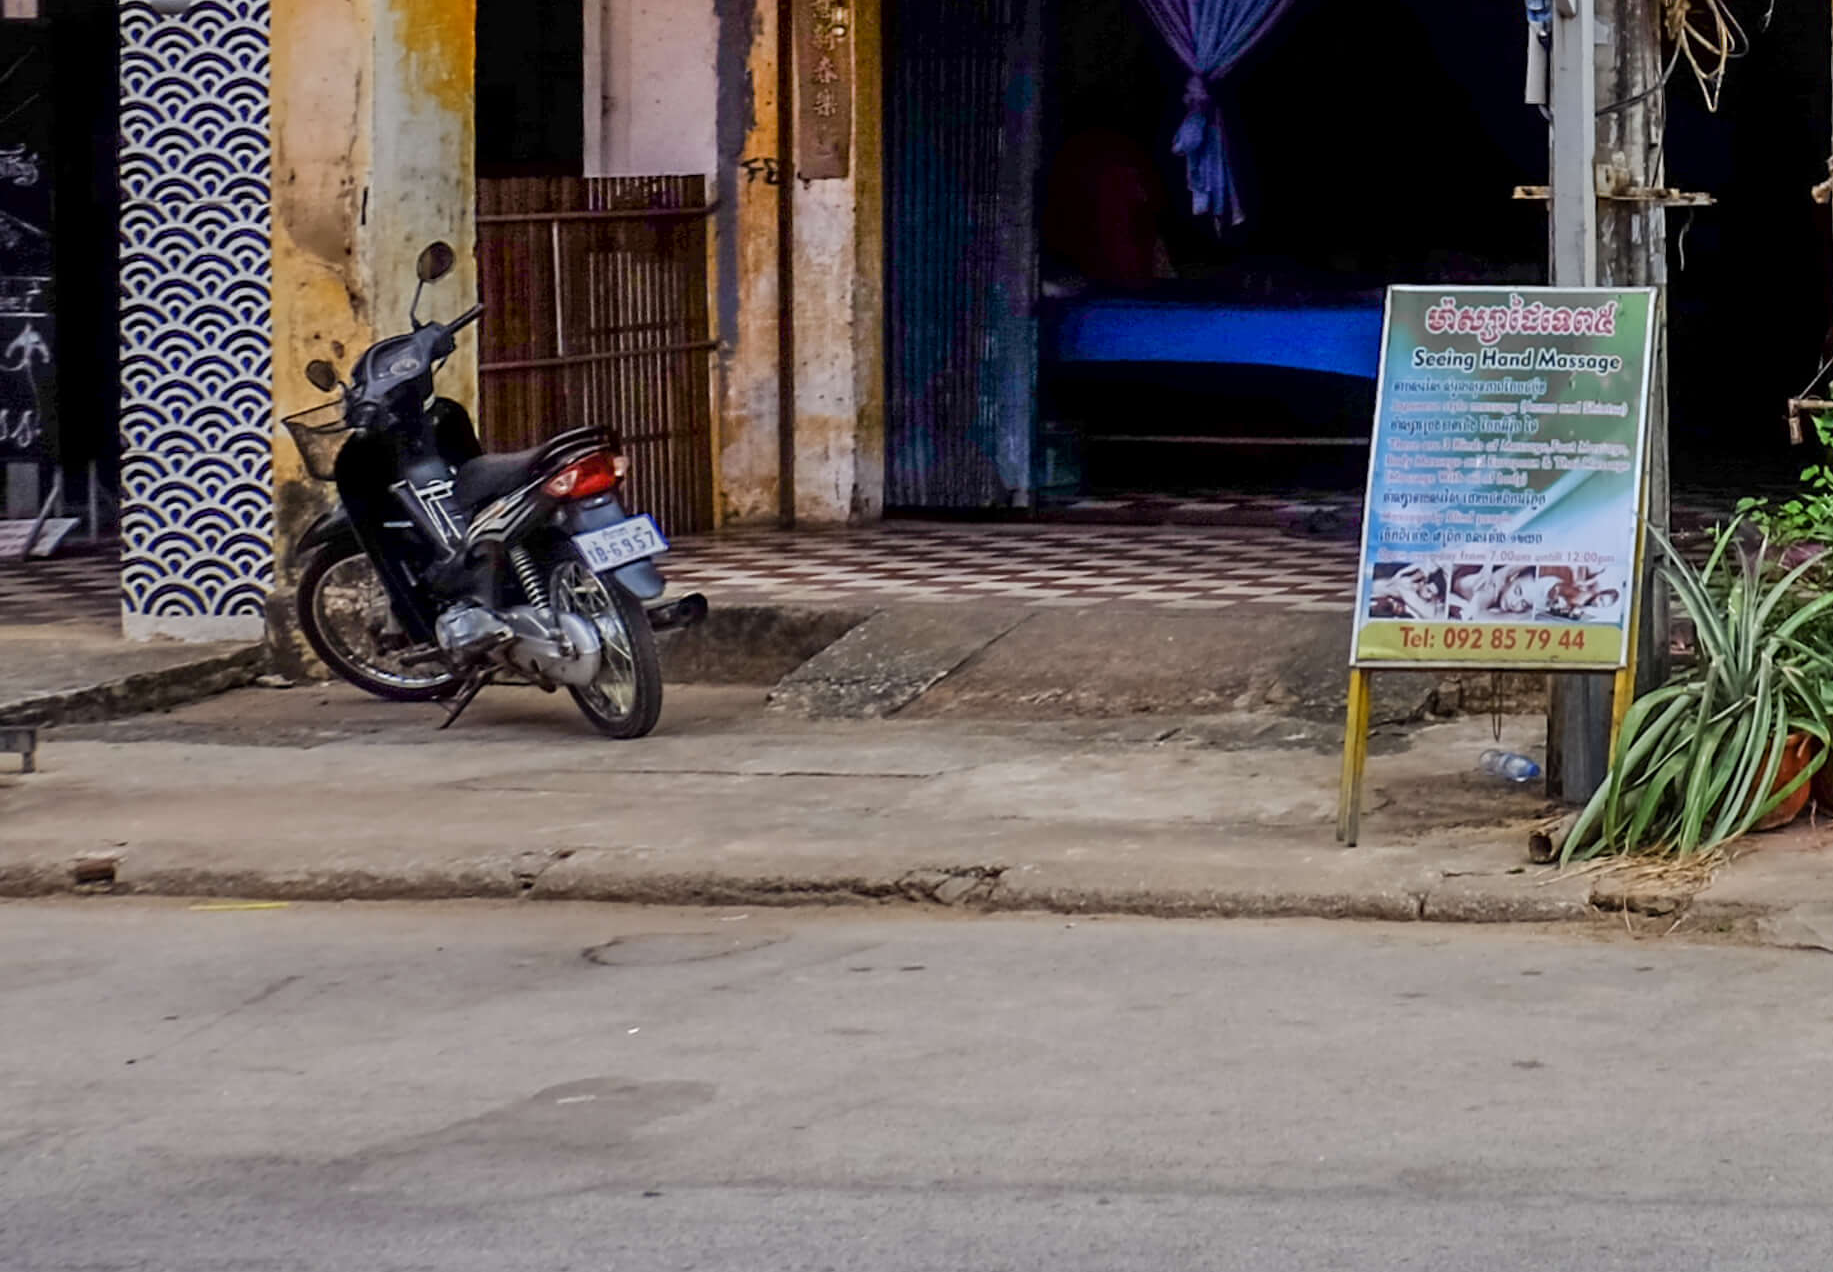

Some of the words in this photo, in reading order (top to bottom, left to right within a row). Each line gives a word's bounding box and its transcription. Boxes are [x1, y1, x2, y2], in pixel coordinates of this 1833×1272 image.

[1414, 349, 1475, 371] Seeing
[1482, 350, 1532, 368] Hand
[1538, 353, 1622, 374] Massage
[1400, 626, 1435, 649] Tel:
[1443, 627, 1484, 650] 092
[1490, 628, 1517, 650] 85
[1525, 628, 1551, 651] 79
[1557, 629, 1585, 651] 44
